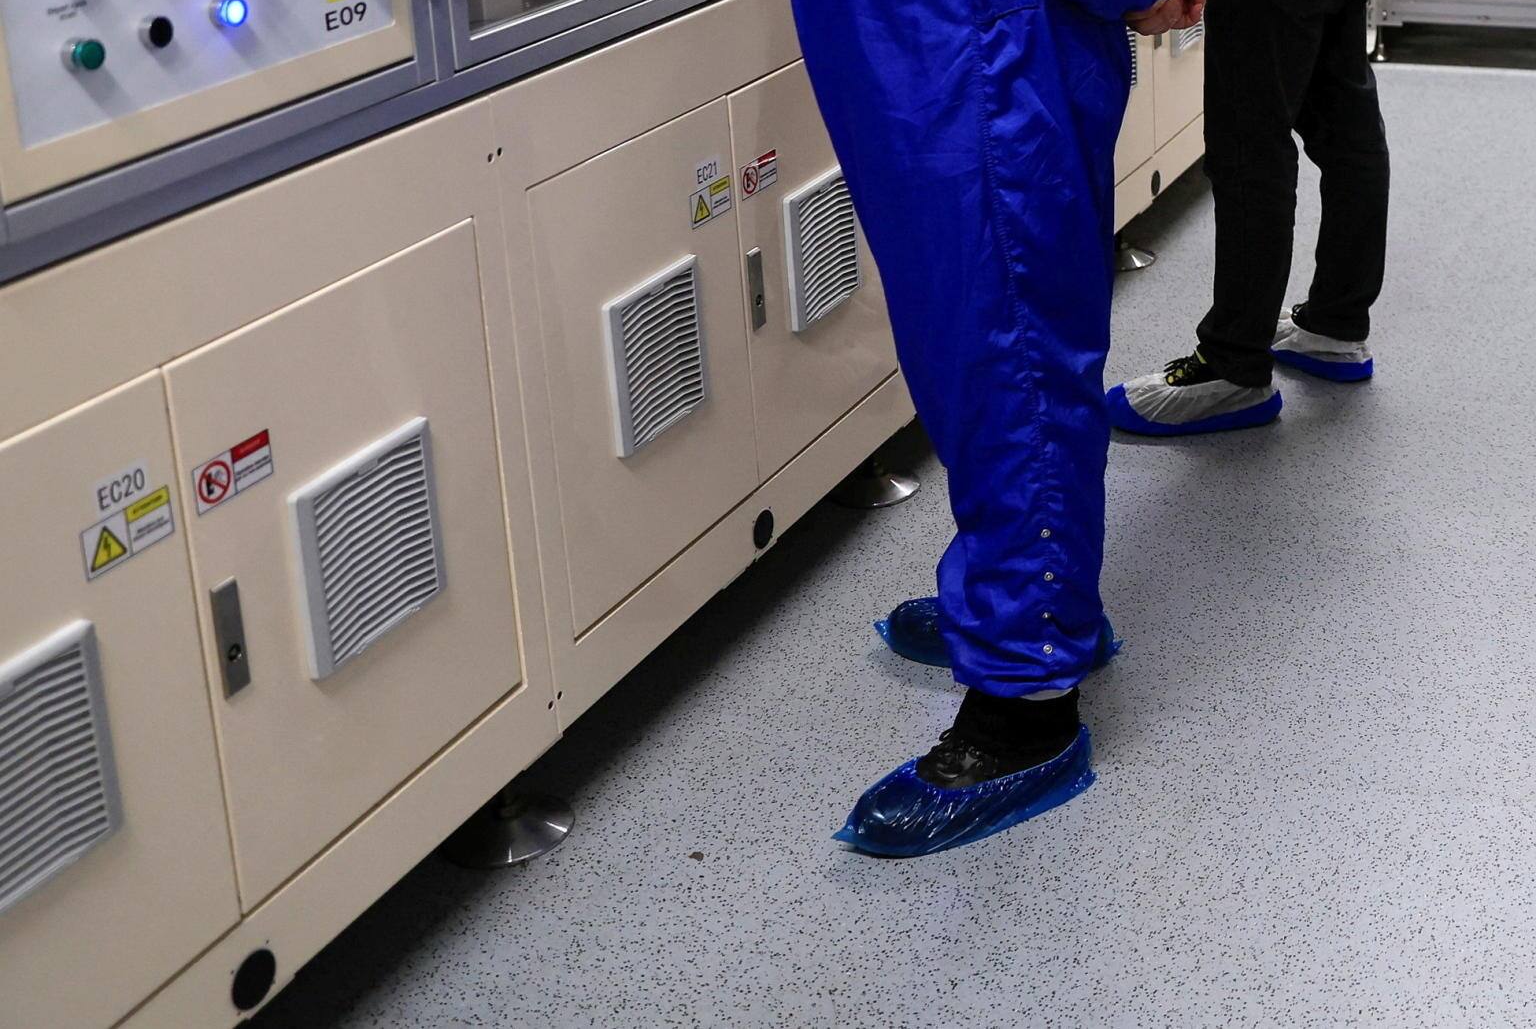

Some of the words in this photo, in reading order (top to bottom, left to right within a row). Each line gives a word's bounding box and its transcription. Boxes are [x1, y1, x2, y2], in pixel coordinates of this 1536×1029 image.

[325, 1, 367, 31] E09
[697, 161, 718, 185] EC21
[97, 468, 145, 511] EC20
